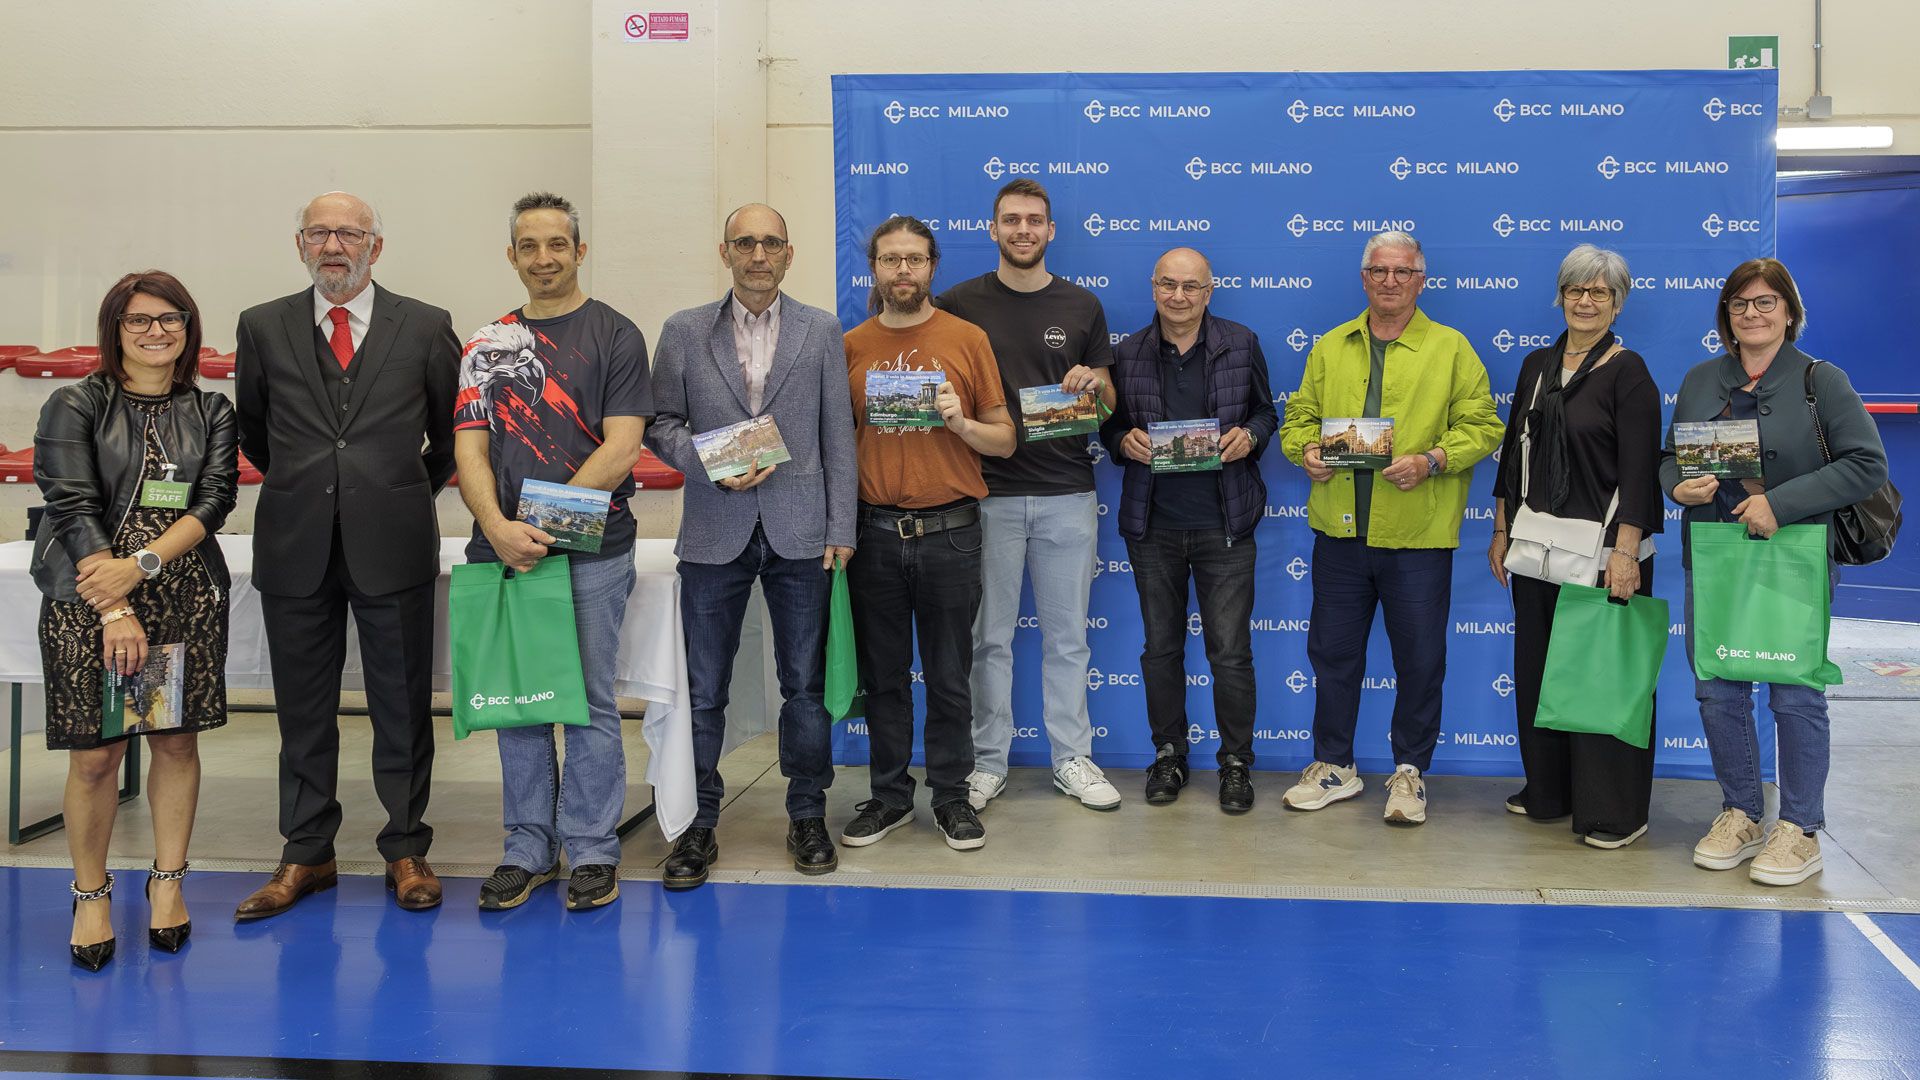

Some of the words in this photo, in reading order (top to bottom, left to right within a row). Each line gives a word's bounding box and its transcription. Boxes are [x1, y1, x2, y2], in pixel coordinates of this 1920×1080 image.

[910, 107, 939, 117] BCC
[949, 106, 1008, 117] MILANO
[1110, 106, 1140, 117] BCC
[1150, 106, 1210, 117] MILANO
[1314, 106, 1344, 117] BCC
[1354, 106, 1415, 116] MILANO
[1520, 104, 1551, 116] BCC
[1561, 104, 1624, 115] MILANO
[1731, 104, 1762, 115] BCC
[851, 163, 908, 175] MILANO
[1010, 163, 1039, 174] BCC
[1049, 163, 1109, 173] MILANO
[1211, 163, 1241, 174] BCC
[1252, 163, 1312, 174] MILANO
[1416, 163, 1447, 174] BCC
[1457, 162, 1519, 173] MILANO
[1625, 162, 1656, 173] BCC
[1666, 162, 1728, 173] MILANO
[920, 219, 940, 231] CC
[1110, 220, 1140, 230] BCC
[1150, 220, 1210, 231] MILANO
[1313, 220, 1343, 231] BCC
[1353, 220, 1415, 231] MILANO
[1520, 220, 1550, 231] BCC
[1561, 220, 1623, 231] MILANO
[1728, 220, 1759, 232] BCC
[1213, 277, 1242, 289] BCC
[1251, 277, 1312, 288] MILANO
[1457, 278, 1518, 289] MILANO
[1665, 278, 1727, 290] MILANO
[1519, 335, 1551, 347] BCC
[148, 494, 182, 502] STAFF
[1264, 506, 1308, 517] ILANO
[1015, 617, 1038, 629] CC
[1250, 620, 1310, 632] MILANO
[1456, 623, 1515, 635] MILANO
[1730, 650, 1750, 658] BCC
[1756, 651, 1796, 661] MILANO
[1108, 674, 1139, 686] BCC
[488, 696, 509, 705] BCC
[515, 691, 554, 704] MILANO
[1253, 731, 1311, 742] MILANO
[1454, 733, 1517, 746] MILANO
